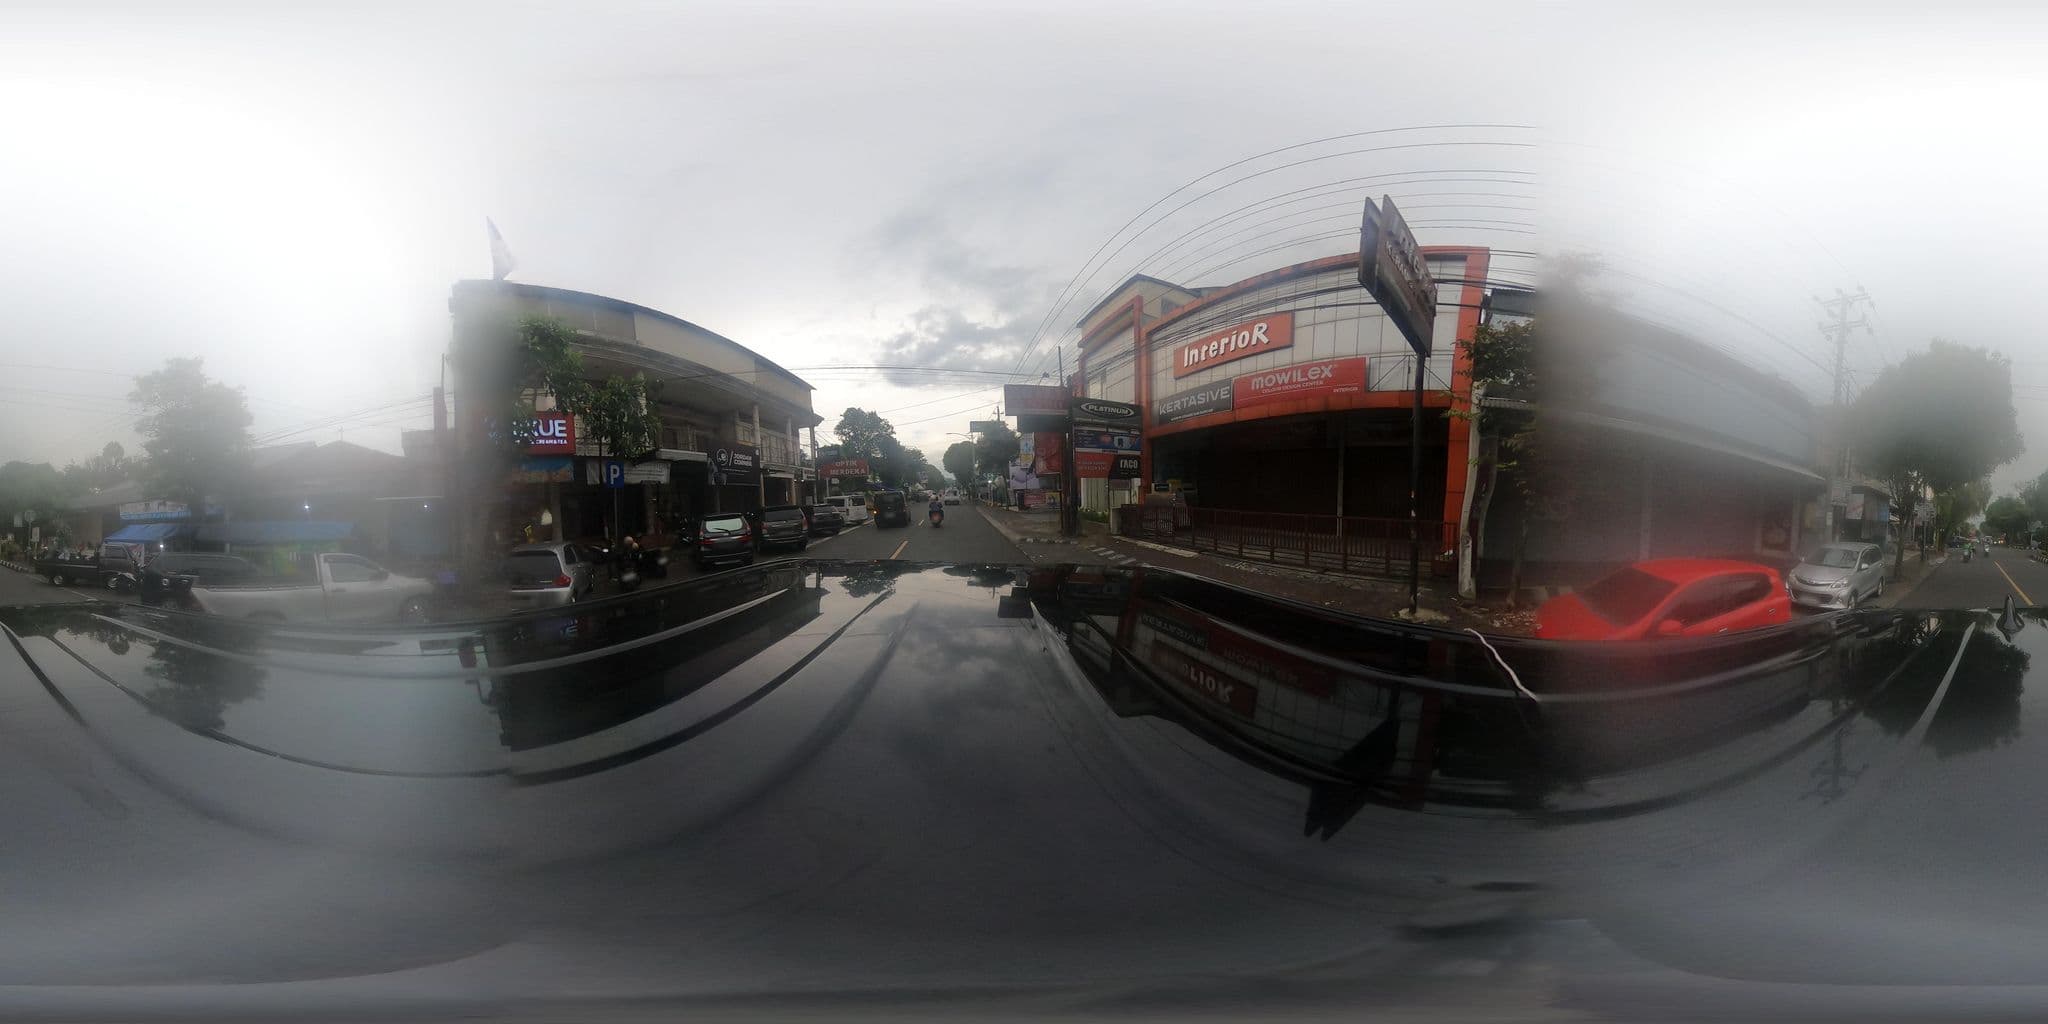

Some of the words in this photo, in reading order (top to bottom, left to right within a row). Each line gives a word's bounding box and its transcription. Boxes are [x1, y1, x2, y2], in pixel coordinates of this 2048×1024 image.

[1183, 322, 1270, 368] InterioR
[1088, 404, 1129, 415] PLATINUM
[1159, 386, 1230, 415] KERTASIVE
[610, 465, 620, 485] P
